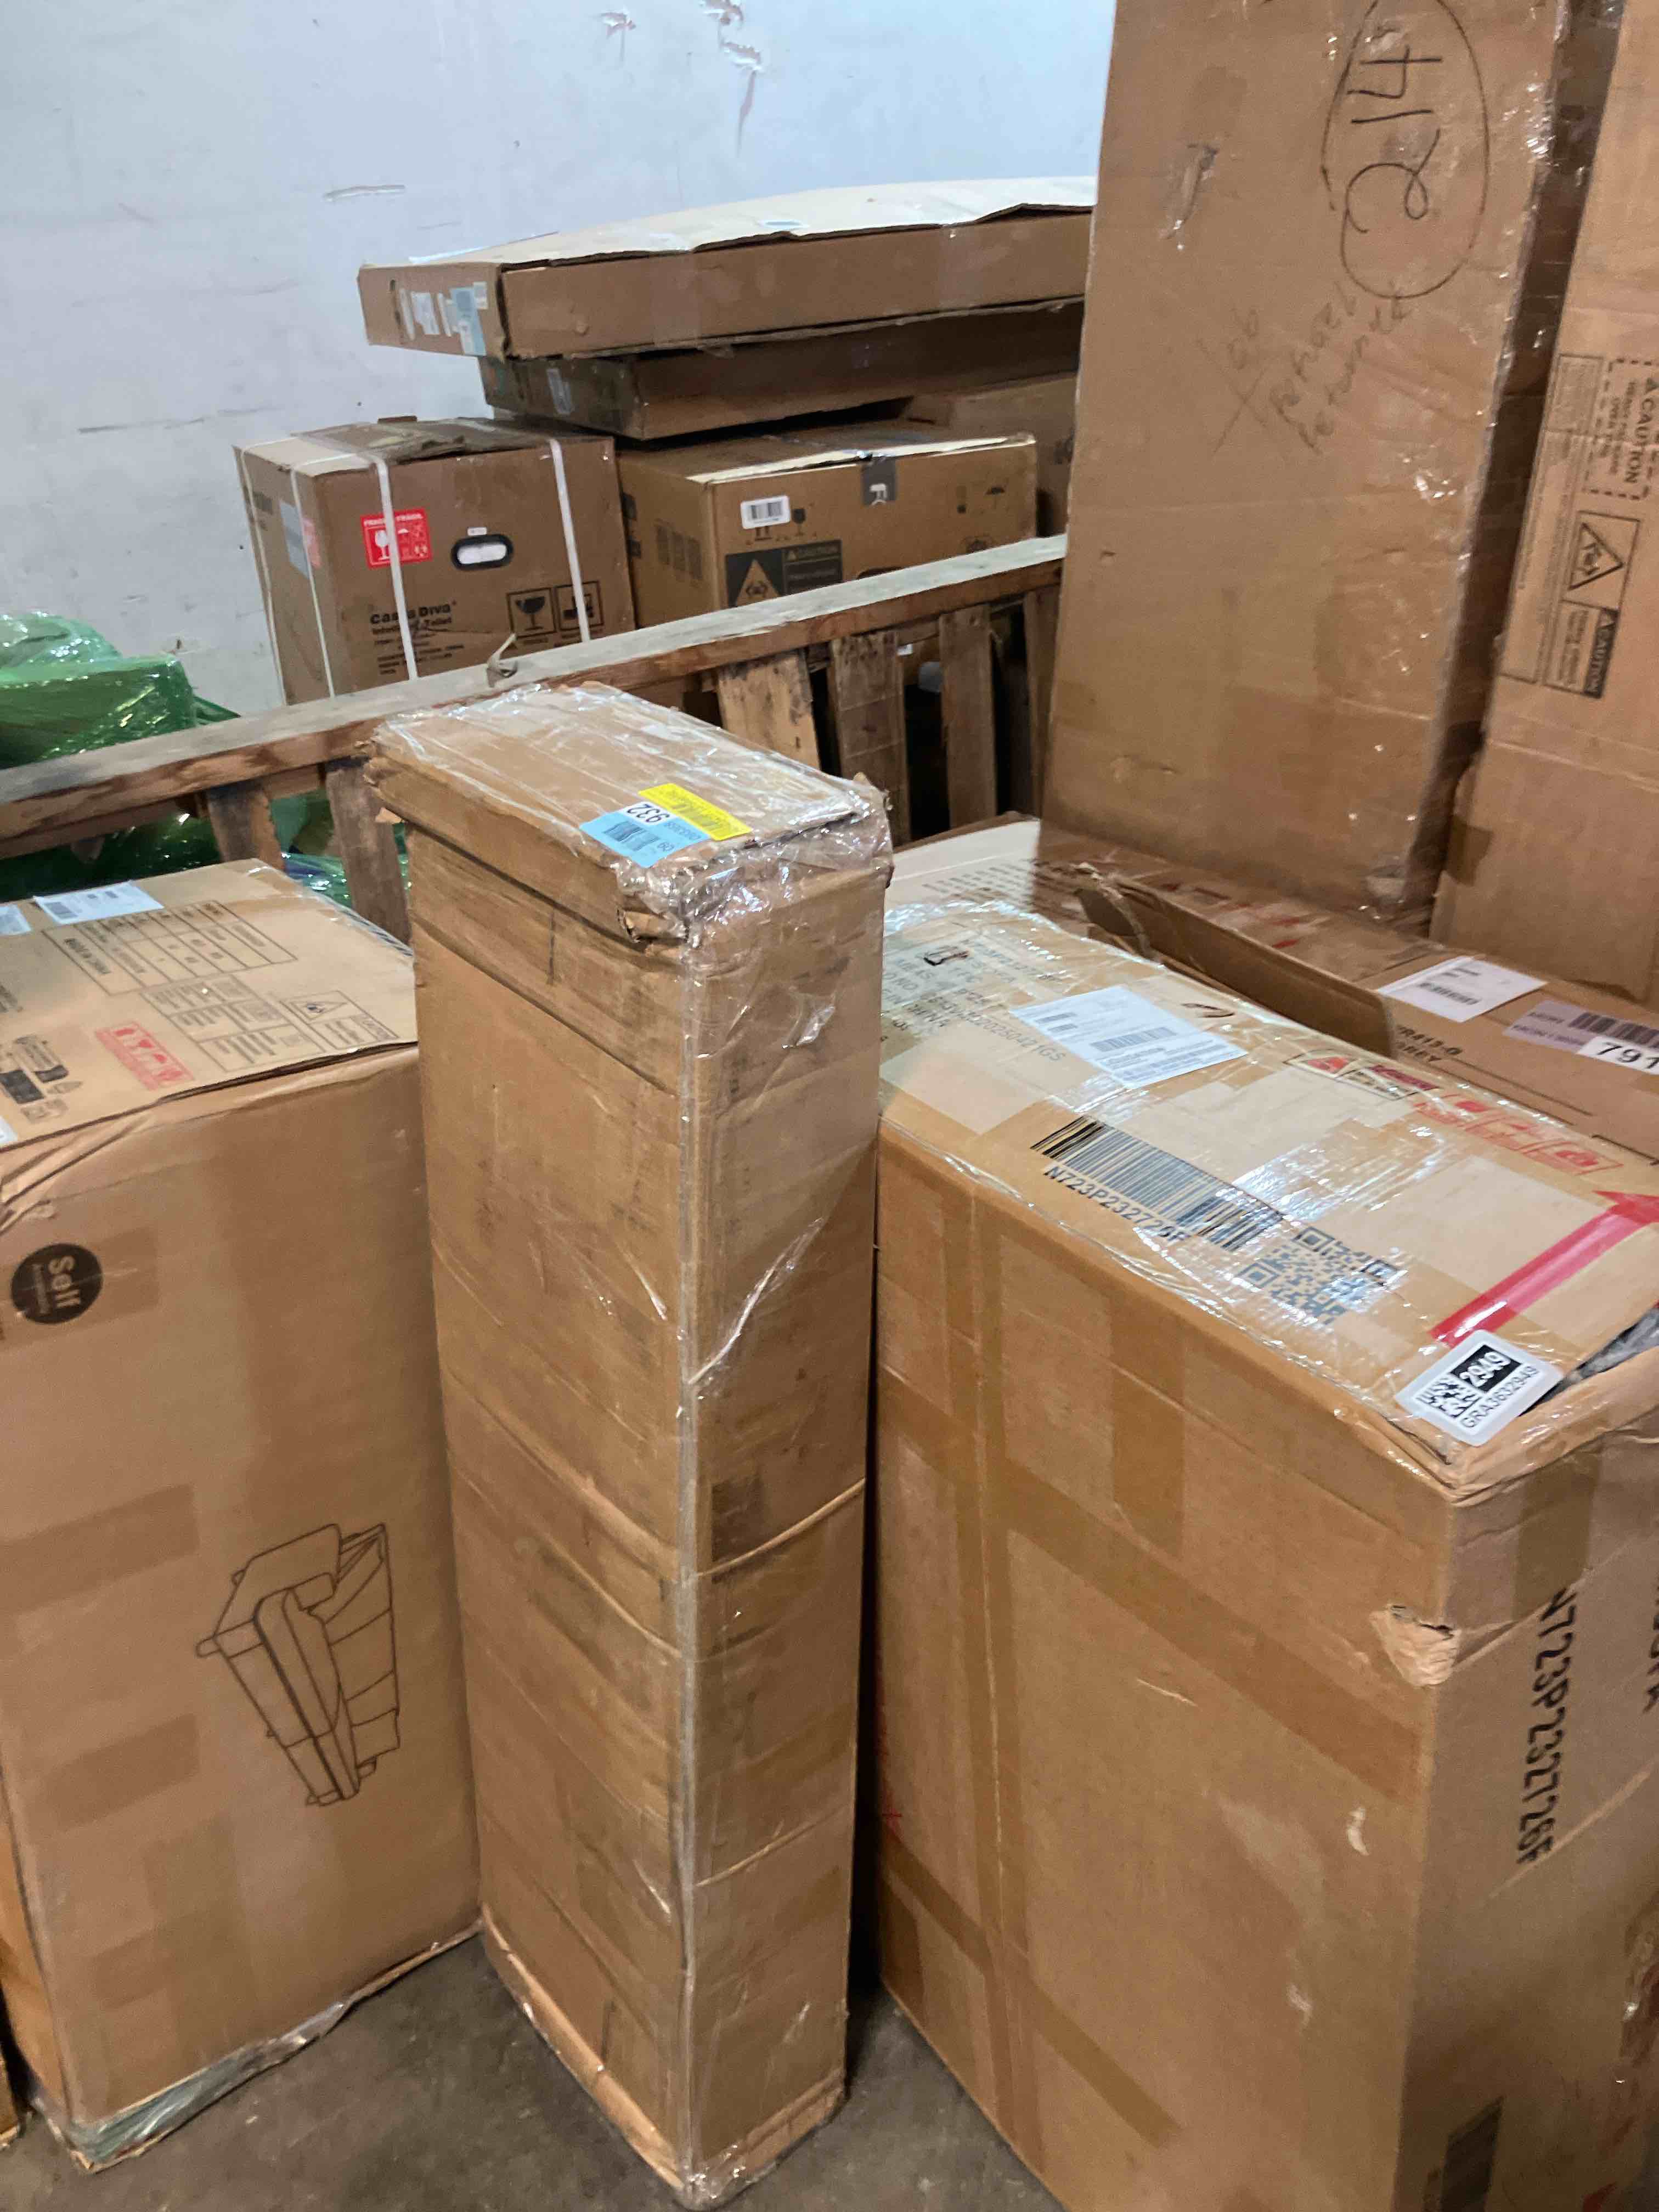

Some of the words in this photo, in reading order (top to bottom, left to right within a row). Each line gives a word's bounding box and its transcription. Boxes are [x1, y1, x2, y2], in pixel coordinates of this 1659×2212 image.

[1624, 398, 1656, 483] CAUTION
[627, 804, 670, 824] 932
[1460, 1352, 1511, 1387] 2949
